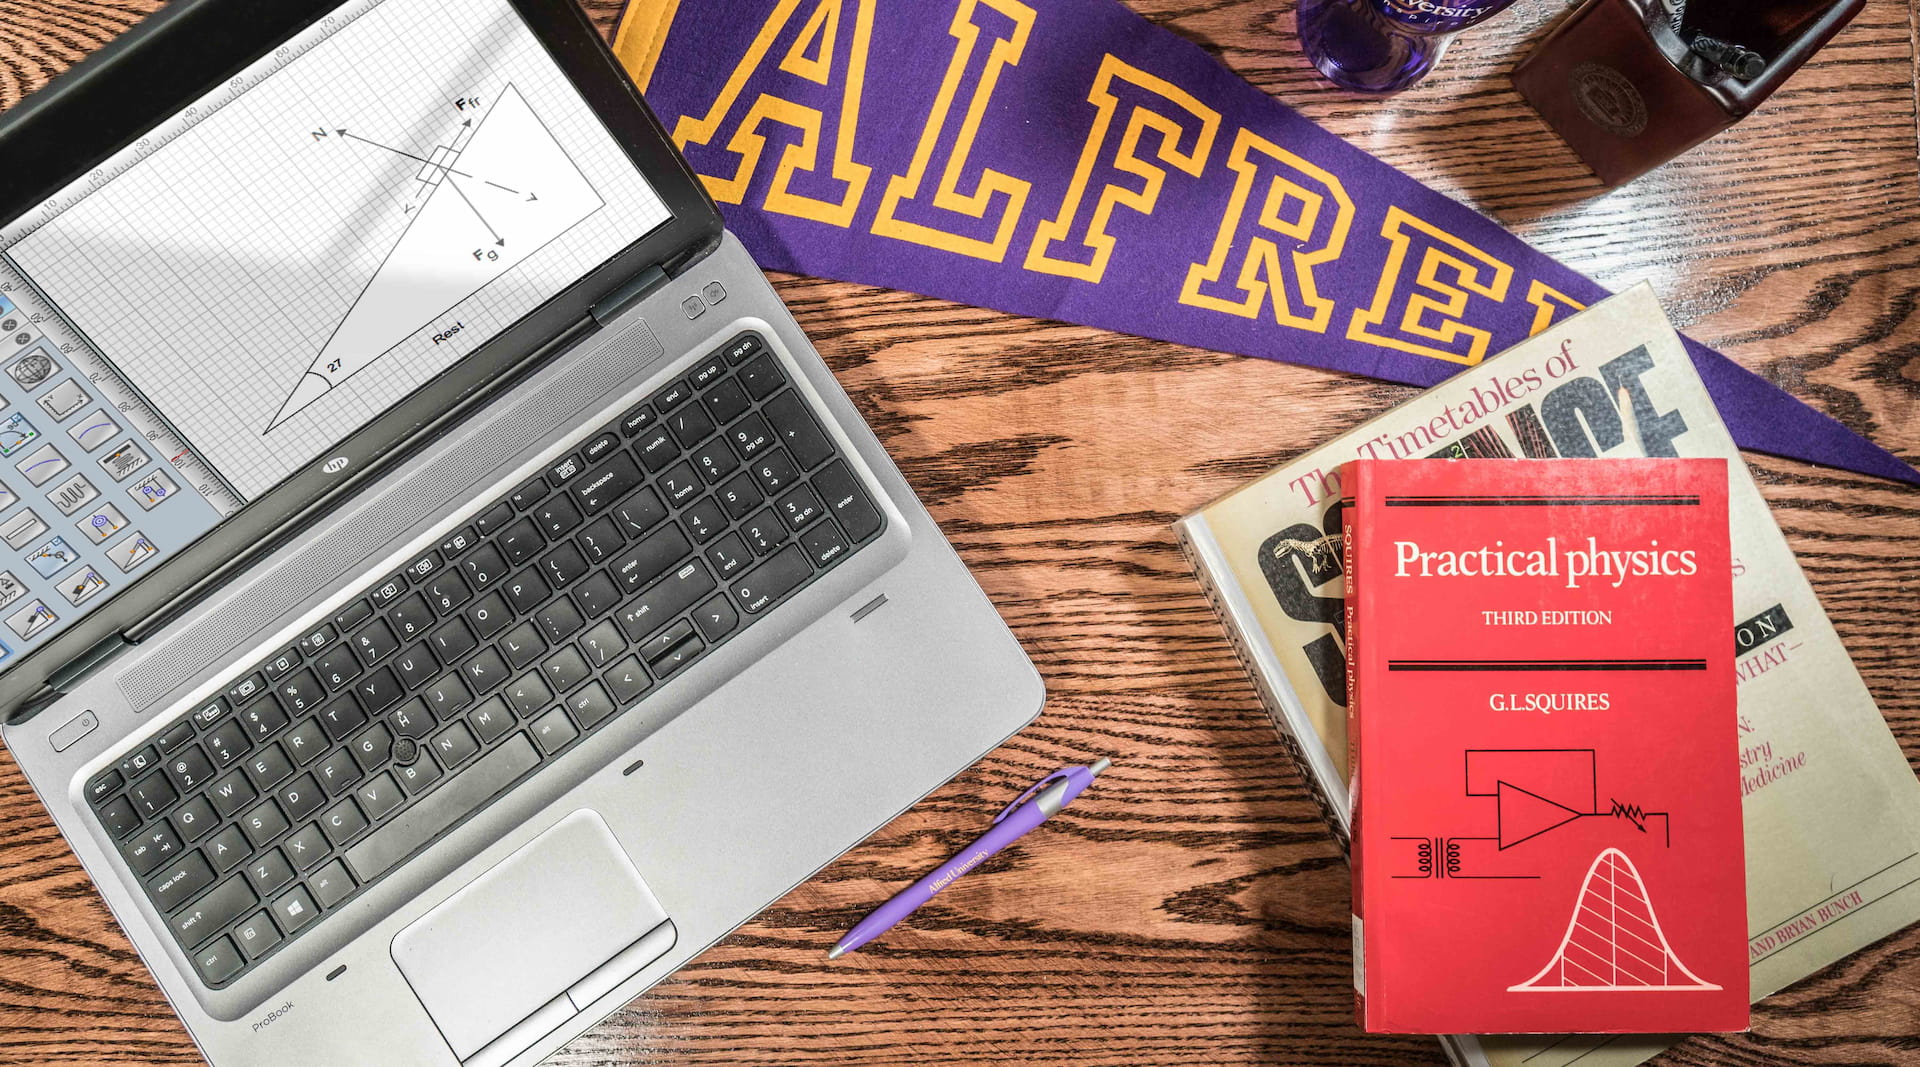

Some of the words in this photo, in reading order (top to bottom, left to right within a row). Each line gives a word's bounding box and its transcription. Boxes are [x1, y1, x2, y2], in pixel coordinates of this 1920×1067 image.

[312, 127, 328, 142] N
[672, 0, 1586, 367] ALFRE
[431, 320, 465, 345] Rest
[326, 358, 343, 373] 27
[666, 391, 679, 402] end
[627, 413, 647, 428] home
[1289, 467, 1341, 507] Th
[1357, 368, 1542, 459] Timetables
[1546, 339, 1578, 379] of
[738, 432, 747, 442] 9
[589, 439, 609, 455] delete
[646, 436, 666, 452] numlk
[703, 456, 712, 467] 8
[762, 467, 772, 477] 6
[581, 472, 614, 496] backspace
[667, 480, 675, 490] 7
[674, 485, 693, 499] home
[727, 492, 737, 502] 5
[786, 503, 796, 513] 3
[837, 495, 854, 509] enter
[692, 516, 701, 526] 4
[751, 527, 761, 538] 2
[821, 545, 841, 561] delete
[1344, 524, 1353, 594] SQUIRES
[621, 559, 638, 573] enter
[724, 559, 737, 571] end
[1394, 537, 1559, 577] Practical
[1565, 537, 1697, 588] physics
[478, 572, 487, 582] 0
[513, 585, 522, 596] P
[741, 588, 750, 598] 0
[442, 598, 450, 608] 9
[750, 595, 769, 610] insert
[477, 609, 488, 620] O
[635, 604, 650, 618] shift
[1482, 610, 1538, 625] THIRD
[1541, 610, 1612, 625] EDITION
[405, 623, 414, 633] 8
[1346, 606, 1355, 666] Practical
[509, 642, 519, 651] L
[369, 648, 376, 658] 7
[403, 660, 413, 671] U
[472, 664, 484, 676] K
[332, 674, 341, 683] 6
[366, 684, 376, 695] Y
[1346, 670, 1356, 719] physics
[437, 691, 444, 702] J
[295, 699, 304, 708] 5
[578, 698, 590, 709] ctrl
[1489, 693, 1610, 713] G.L.SQUIRES
[328, 710, 338, 721] T
[399, 715, 410, 727] H
[478, 712, 491, 725] M
[259, 724, 267, 733] 4
[292, 737, 304, 748] R
[363, 741, 373, 752] G
[441, 738, 453, 751] N
[221, 750, 229, 759] 3
[255, 761, 267, 773] E
[325, 767, 334, 778] F
[406, 767, 416, 779] B
[184, 775, 194, 785] 2
[94, 783, 107, 794] esc
[219, 784, 233, 797] W
[367, 789, 377, 800] V
[288, 792, 299, 804] D
[183, 812, 195, 824] Q
[252, 818, 262, 828] S
[331, 816, 342, 826] C
[134, 845, 147, 856] tab
[217, 843, 228, 855] A
[293, 840, 305, 853] X
[257, 866, 269, 879] Z
[929, 873, 952, 894] Alfred
[950, 849, 989, 878] University
[158, 879, 174, 893] caps
[172, 870, 187, 883] lock
[182, 917, 197, 930] shift
[1749, 936, 1776, 959] AND
[1776, 914, 1817, 943] BRYAN
[1818, 891, 1863, 922] BUNCH
[205, 955, 218, 966] ctrl
[252, 1000, 295, 1032] ProBook
